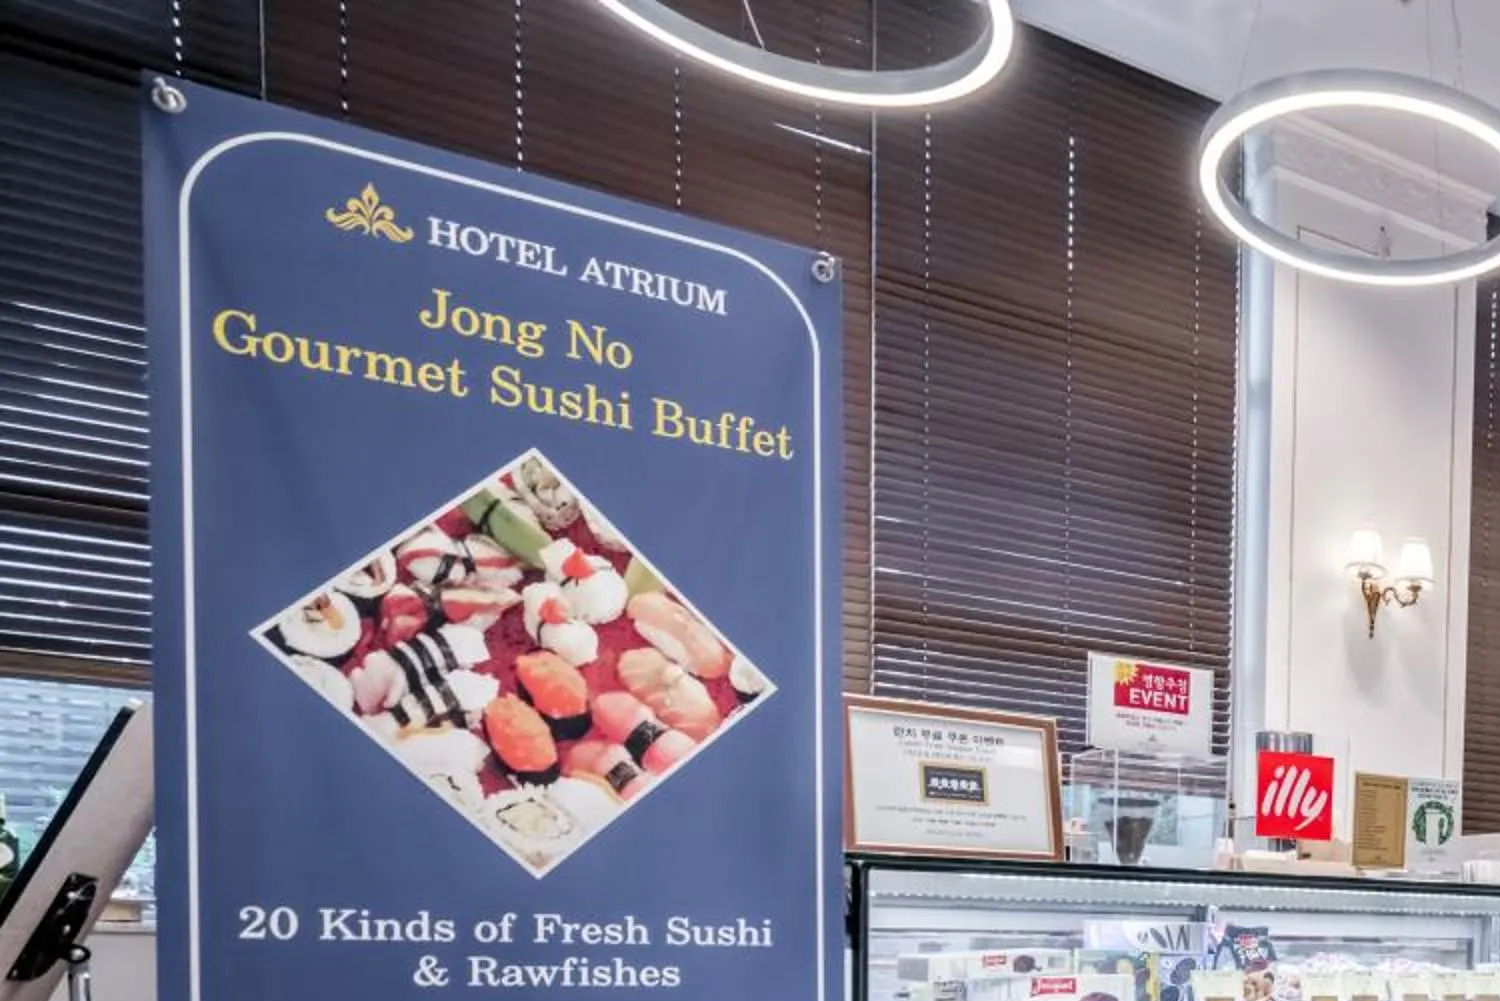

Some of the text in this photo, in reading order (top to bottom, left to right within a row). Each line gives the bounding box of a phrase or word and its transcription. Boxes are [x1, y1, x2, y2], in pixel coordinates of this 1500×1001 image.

[429, 217, 728, 315] HOTEL ATRIUM
[420, 289, 632, 368] Jong No
[214, 310, 793, 460] Gourmet Sushi Buffet
[1129, 687, 1188, 711] EVENT
[1261, 764, 1329, 831] illy
[240, 906, 771, 946] 20 Kinds of Fresh Sushi
[414, 956, 680, 986] & Rawfishes
